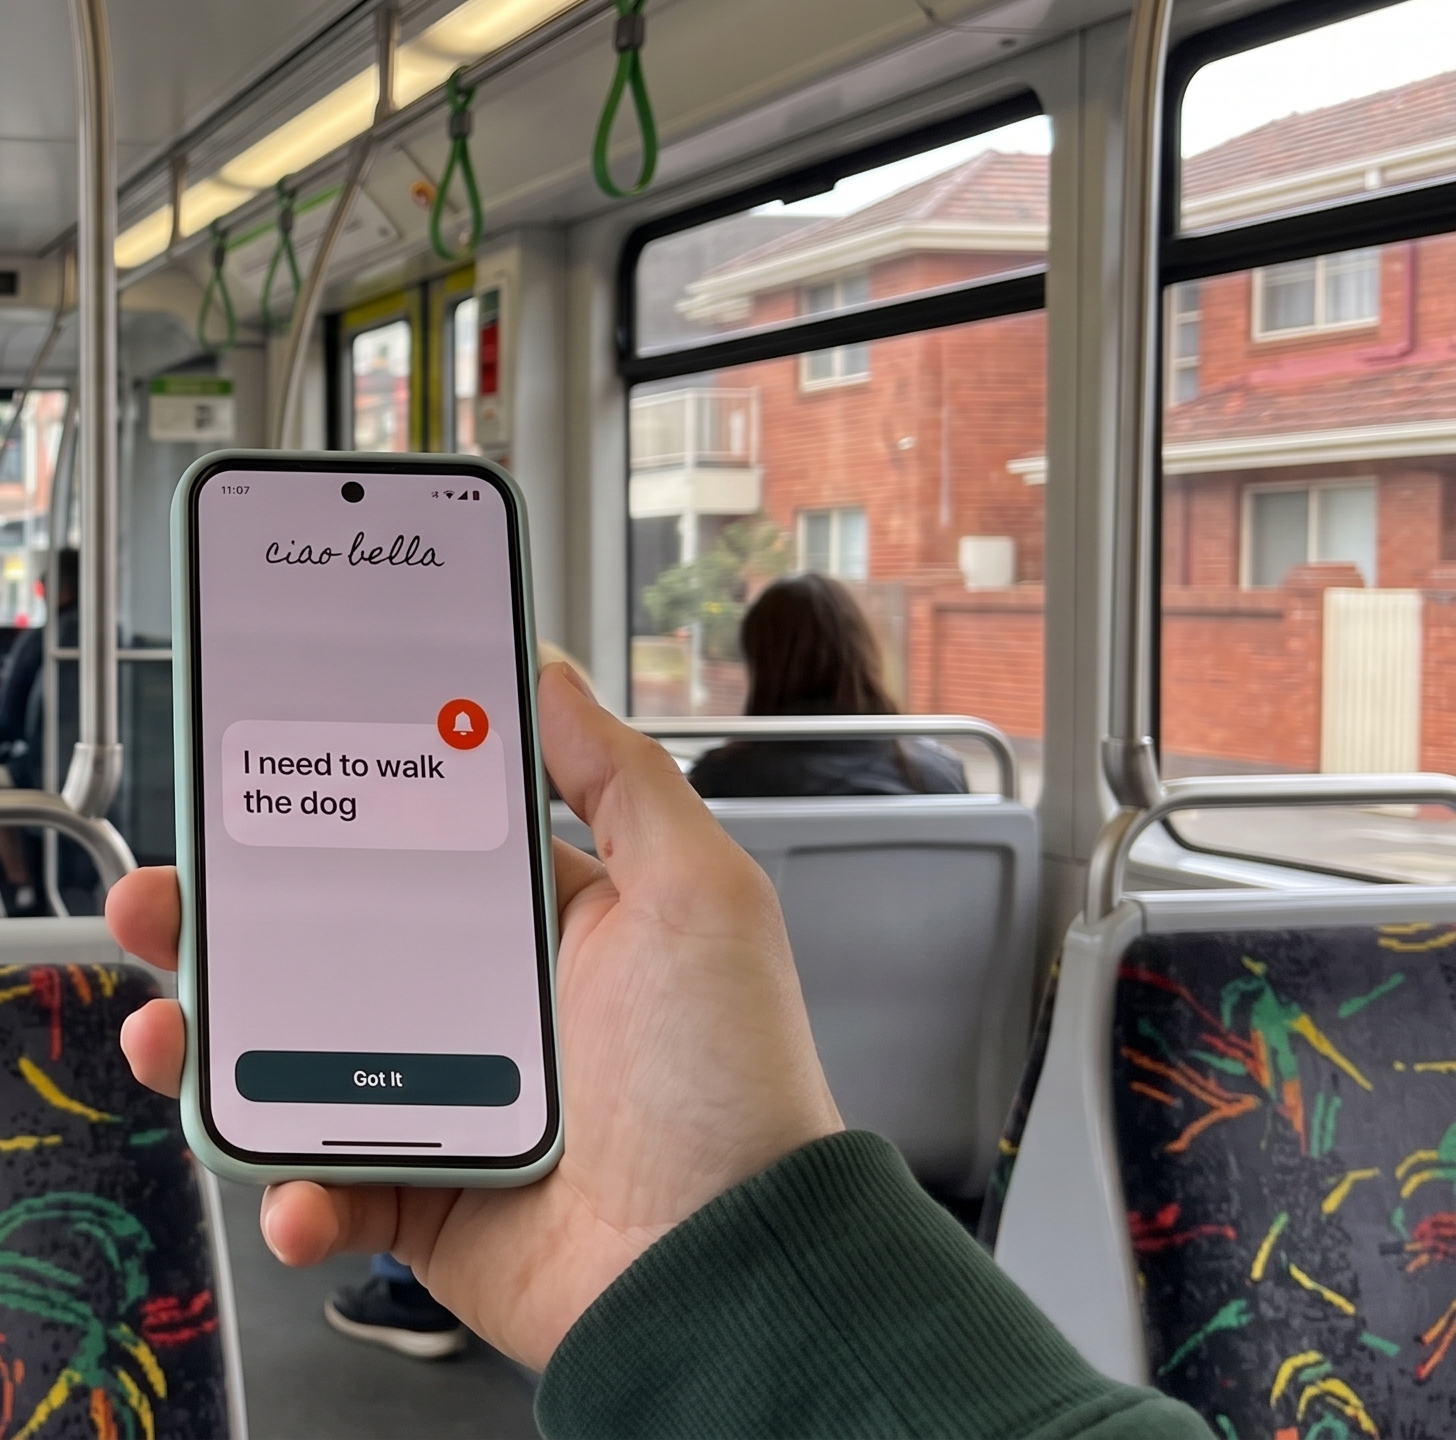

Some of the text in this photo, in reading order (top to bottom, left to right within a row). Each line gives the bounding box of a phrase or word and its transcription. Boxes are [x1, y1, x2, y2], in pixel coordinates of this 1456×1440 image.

[220, 485, 251, 495] 11:07
[265, 531, 446, 568] ciao bella
[243, 749, 446, 779] I need to walk
[242, 789, 357, 822] the dog
[353, 1070, 404, 1088] Got It
